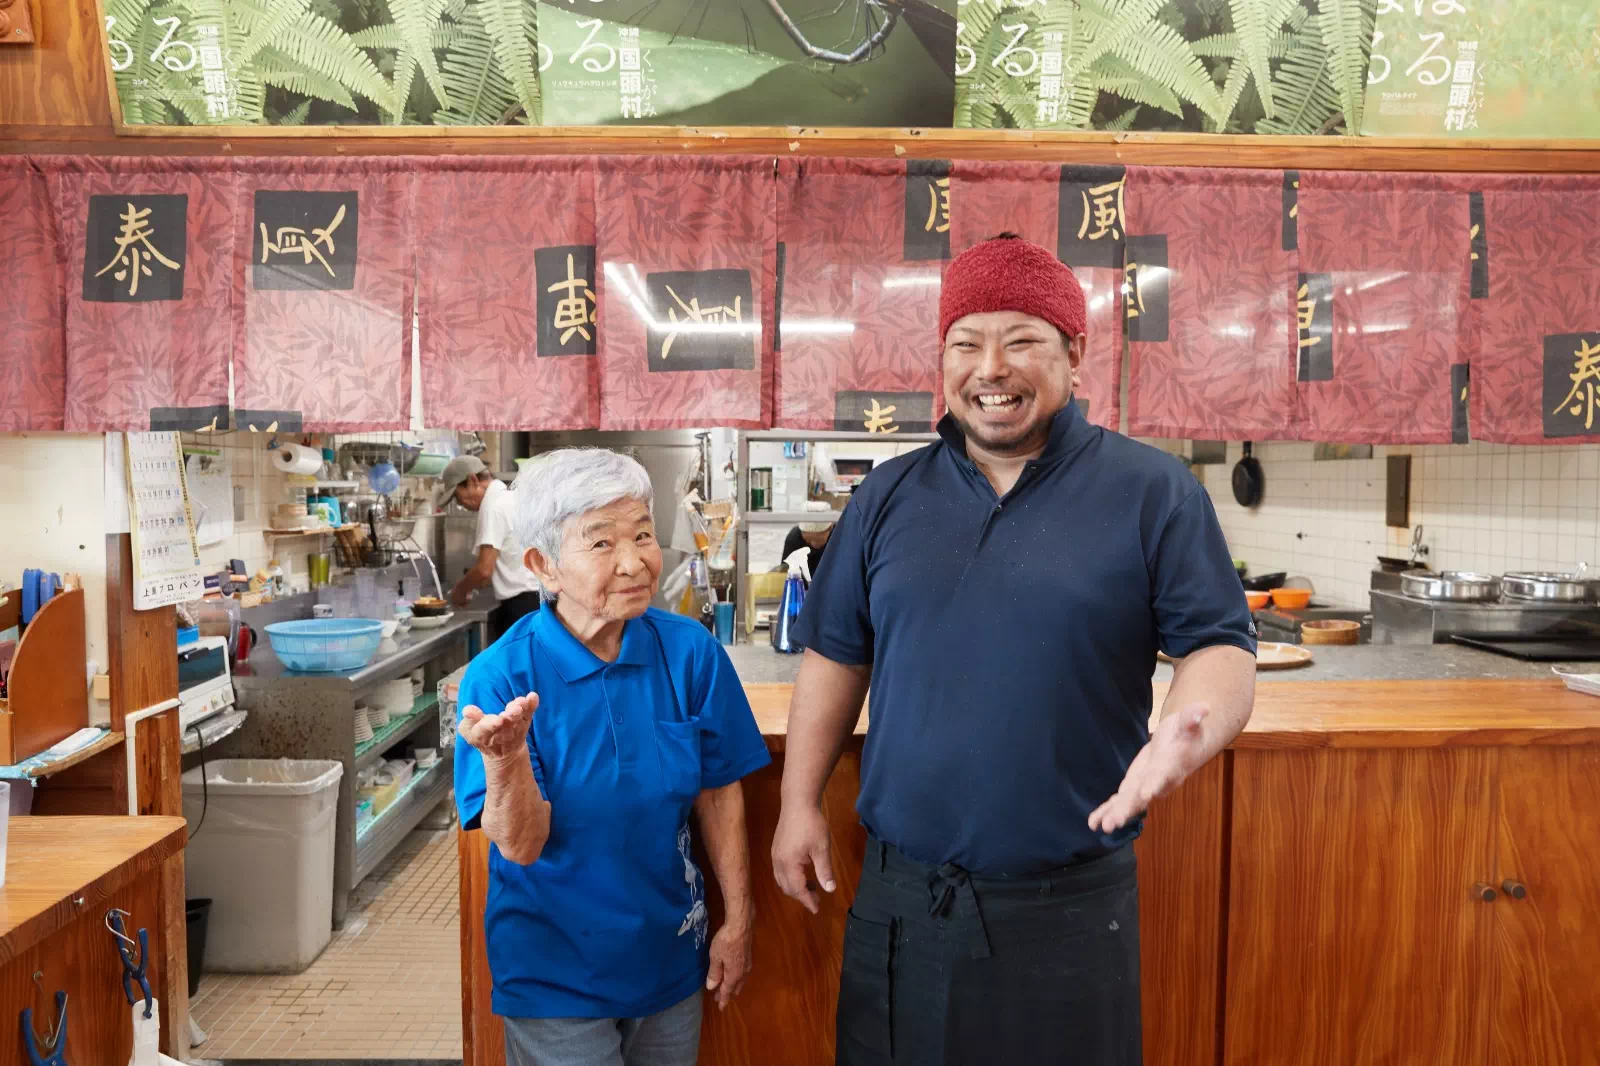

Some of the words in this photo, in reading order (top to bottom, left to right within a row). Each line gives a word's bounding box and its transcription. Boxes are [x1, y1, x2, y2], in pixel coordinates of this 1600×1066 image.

[150, 16, 197, 71] る
[569, 18, 616, 72] る
[1077, 174, 1127, 241] 風
[94, 202, 181, 296] 泰
